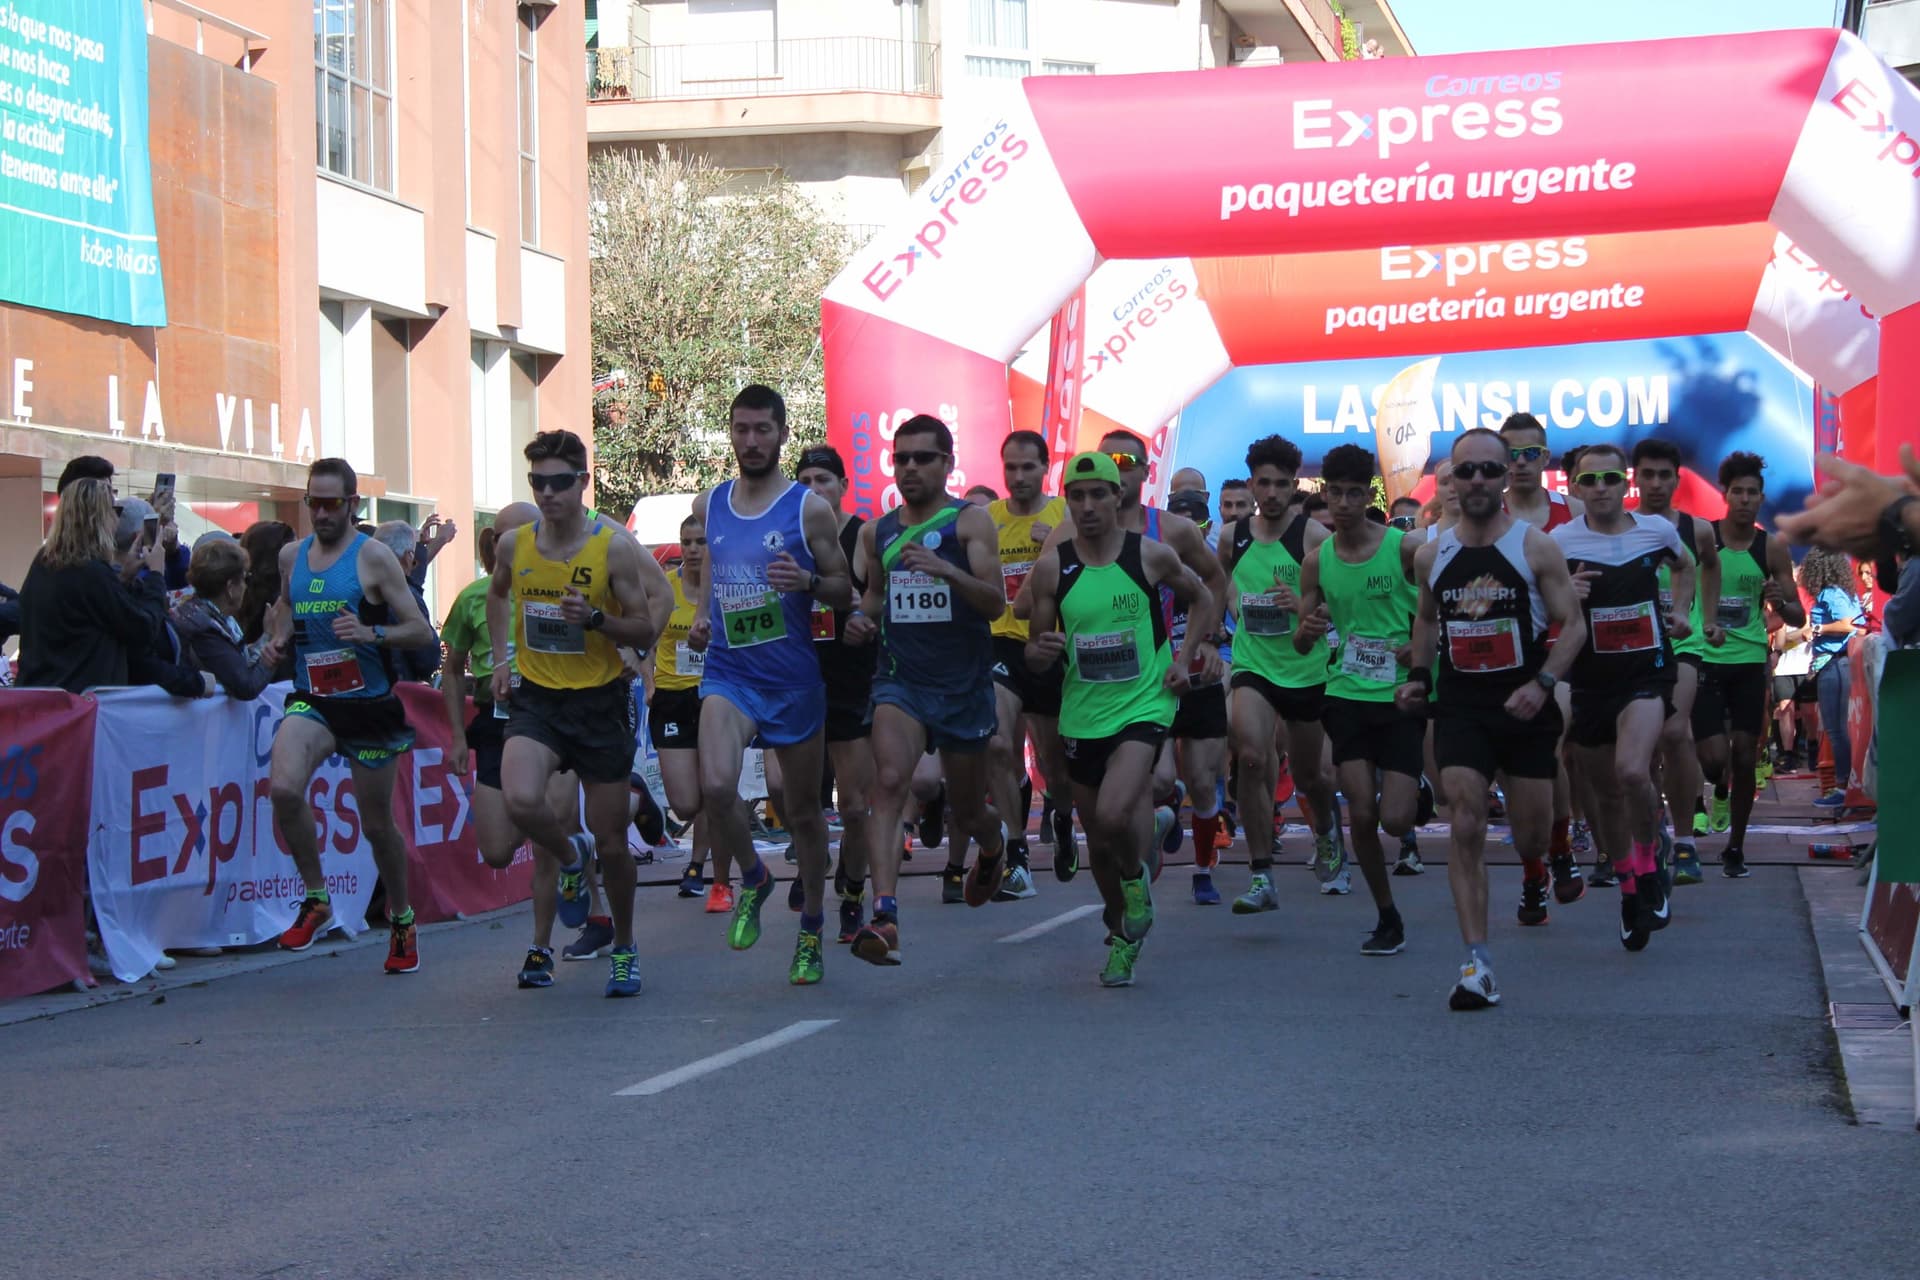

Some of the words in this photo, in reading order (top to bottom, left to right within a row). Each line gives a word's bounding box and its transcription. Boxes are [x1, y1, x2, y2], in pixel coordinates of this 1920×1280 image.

[8, 1, 18, 33] lo
[19, 15, 47, 45] que
[49, 24, 72, 52] nos
[73, 34, 105, 64] pasa
[12, 49, 37, 76] nos
[37, 48, 71, 87] hace
[1425, 70, 1564, 99] Correos
[2, 109, 17, 141] la
[17, 119, 66, 156] actitud
[14, 84, 24, 108] o
[26, 82, 114, 140] desgraciados,
[1292, 95, 1565, 160] Express
[0, 148, 58, 191] tenemos
[928, 117, 1009, 205] Correos
[1219, 160, 1455, 221] paquetería
[1465, 158, 1637, 205] urgente
[861, 132, 1030, 303] Express
[1380, 237, 1589, 287] Express
[1112, 264, 1173, 322] Correos
[1324, 287, 1506, 335] paquetería
[1513, 282, 1645, 322] urgente
[108, 374, 166, 438] LA
[215, 392, 316, 459] VILA
[1303, 374, 1669, 435] LANSI.COM
[852, 411, 874, 522] orreos
[733, 612, 775, 635] 478
[894, 591, 948, 610] 1180
[537, 622, 569, 637] MARC
[1079, 648, 1136, 666] MOHAMED
